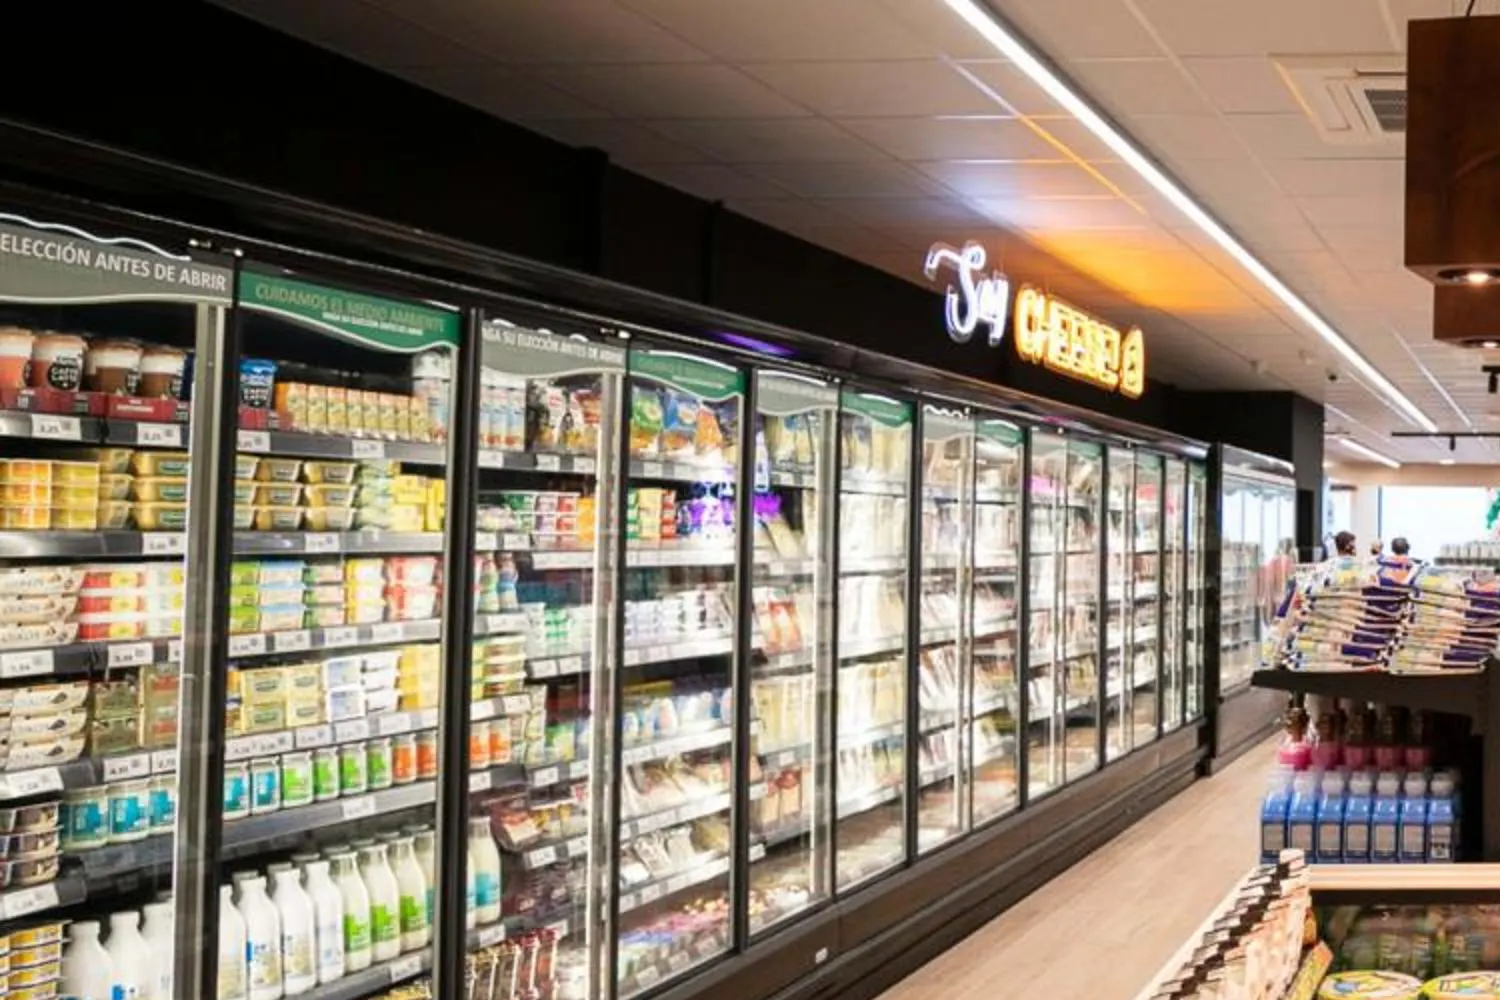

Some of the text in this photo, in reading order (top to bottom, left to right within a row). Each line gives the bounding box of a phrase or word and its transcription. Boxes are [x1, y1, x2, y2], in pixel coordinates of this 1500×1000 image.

[1, 232, 227, 292] ELECCIÓN ANTES DE ABRIR
